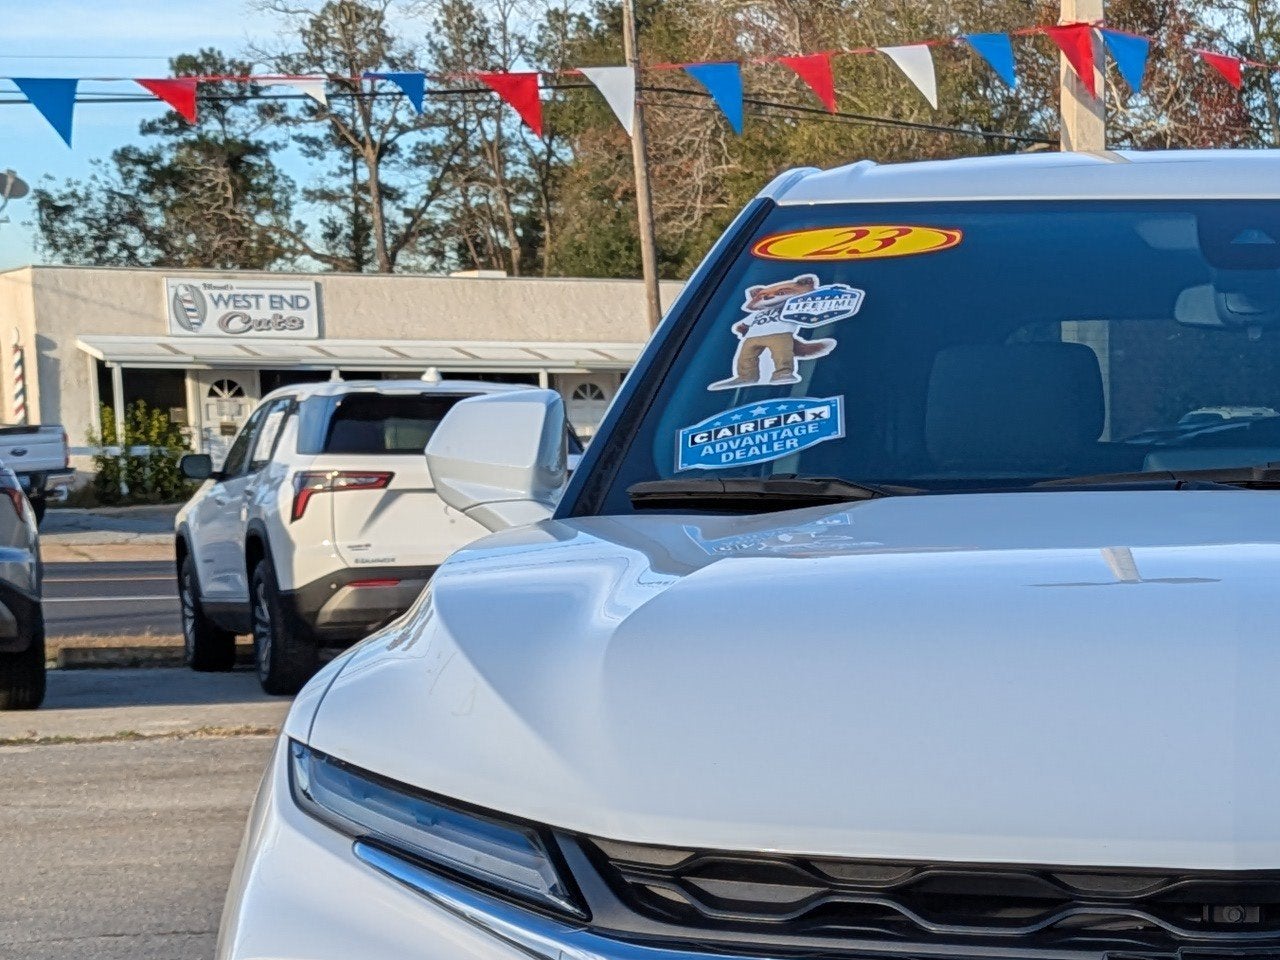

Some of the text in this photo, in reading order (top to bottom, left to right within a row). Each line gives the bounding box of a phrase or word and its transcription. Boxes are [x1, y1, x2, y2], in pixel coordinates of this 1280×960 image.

[802, 228, 913, 257] 23
[208, 293, 310, 311] WEST END
[218, 311, 304, 334] Cuts
[751, 315, 778, 326] FOX
[693, 410, 826, 443] CARFAX
[701, 422, 819, 457] ADVANTAGE
[721, 437, 799, 463] DEALER
